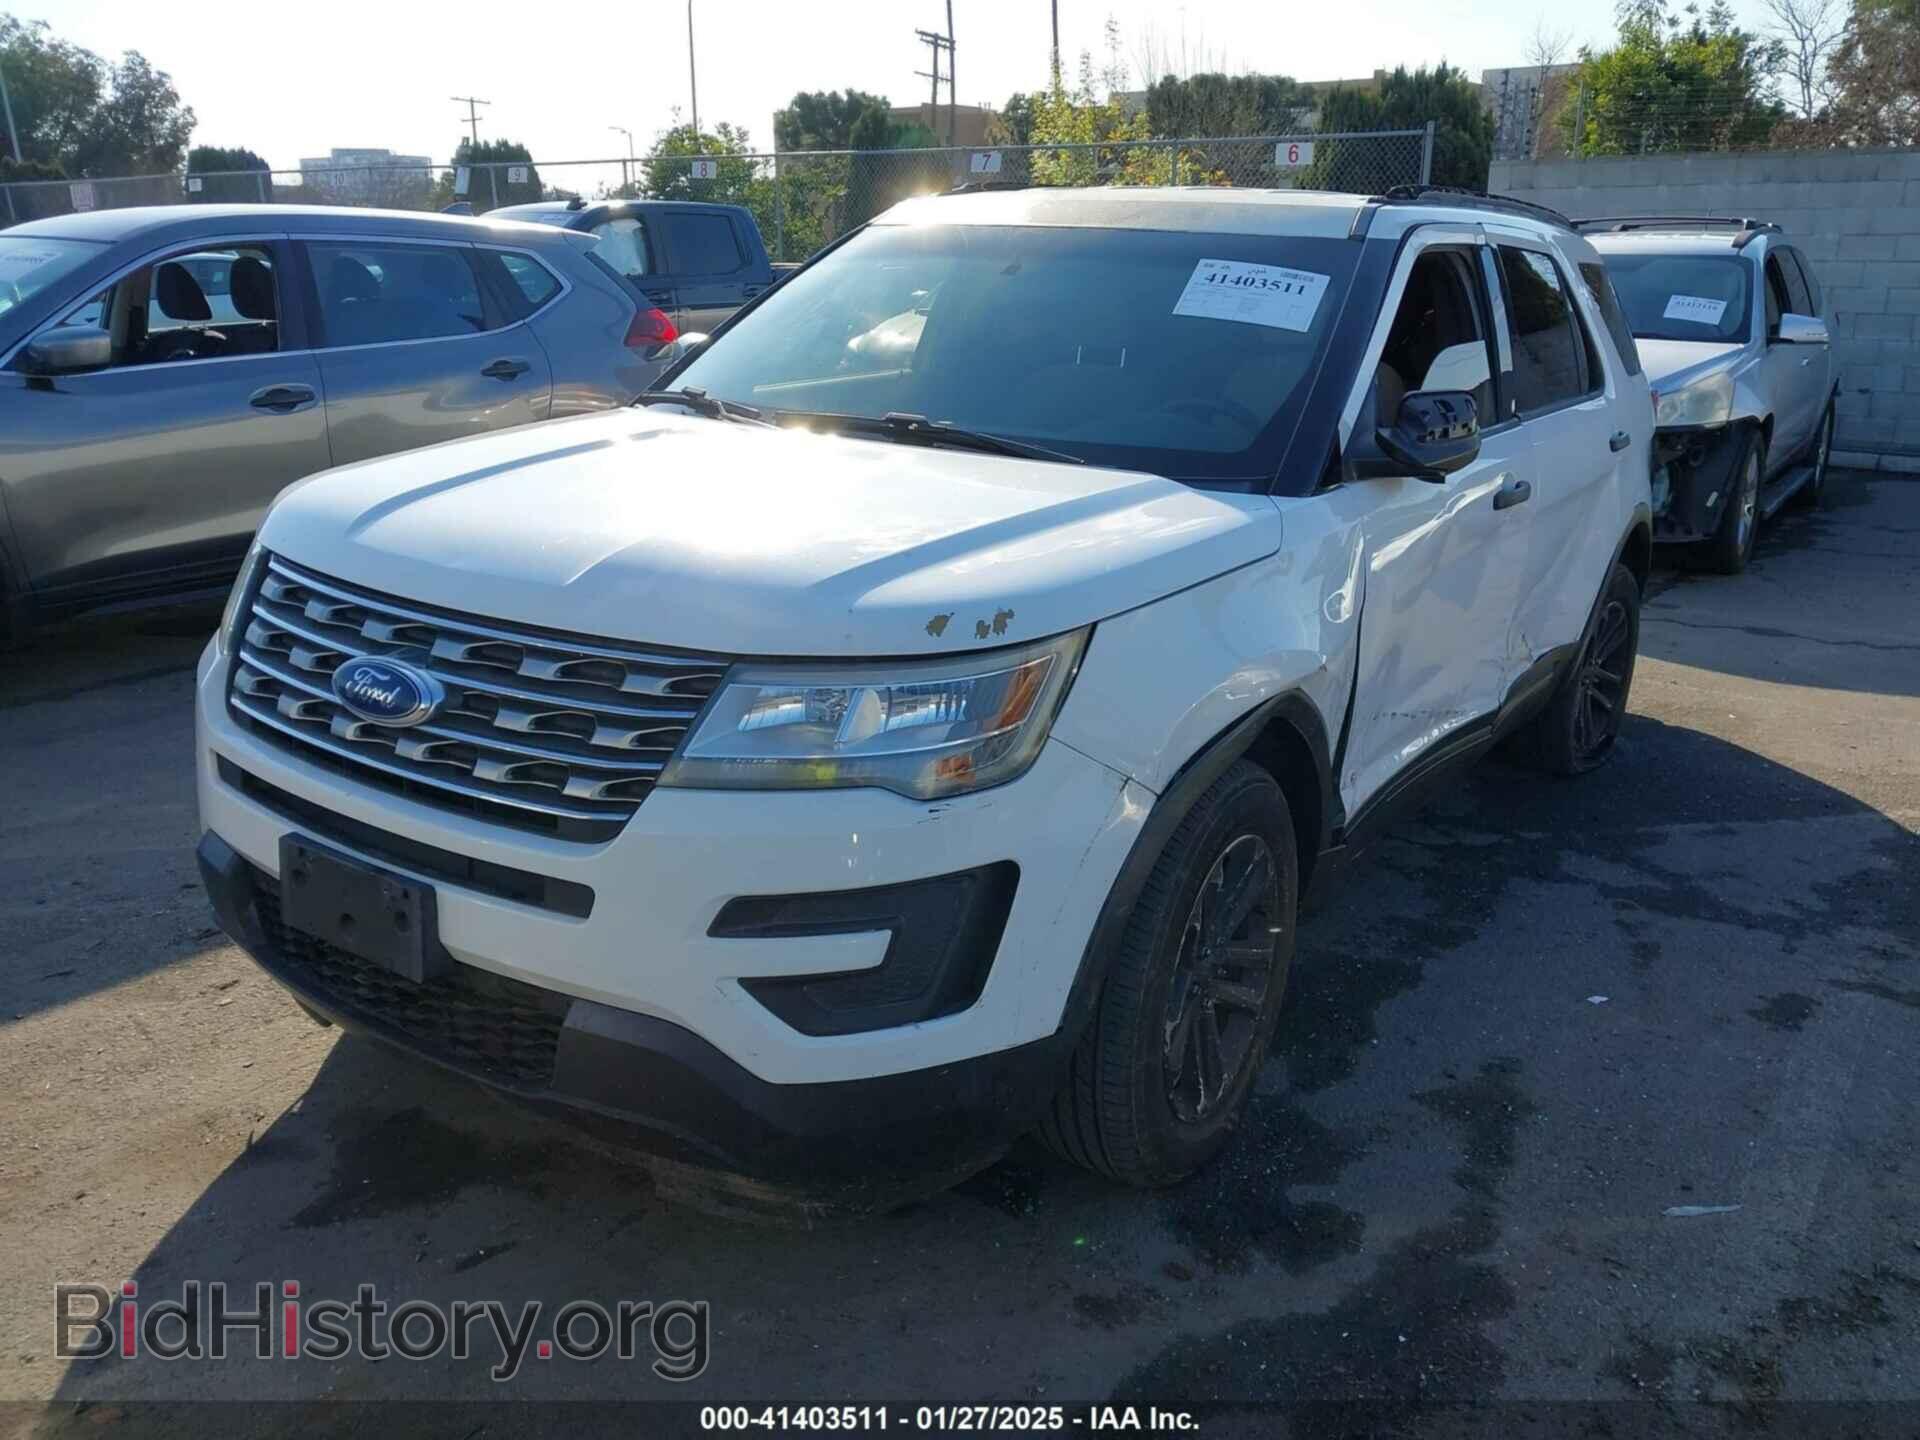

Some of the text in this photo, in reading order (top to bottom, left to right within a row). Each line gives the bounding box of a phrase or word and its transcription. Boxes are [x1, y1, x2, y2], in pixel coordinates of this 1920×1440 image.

[982, 154, 992, 170] 7
[1288, 144, 1299, 164] 6
[700, 162, 708, 177] 8
[1204, 272, 1306, 296] 41403511
[344, 667, 401, 707] Ford
